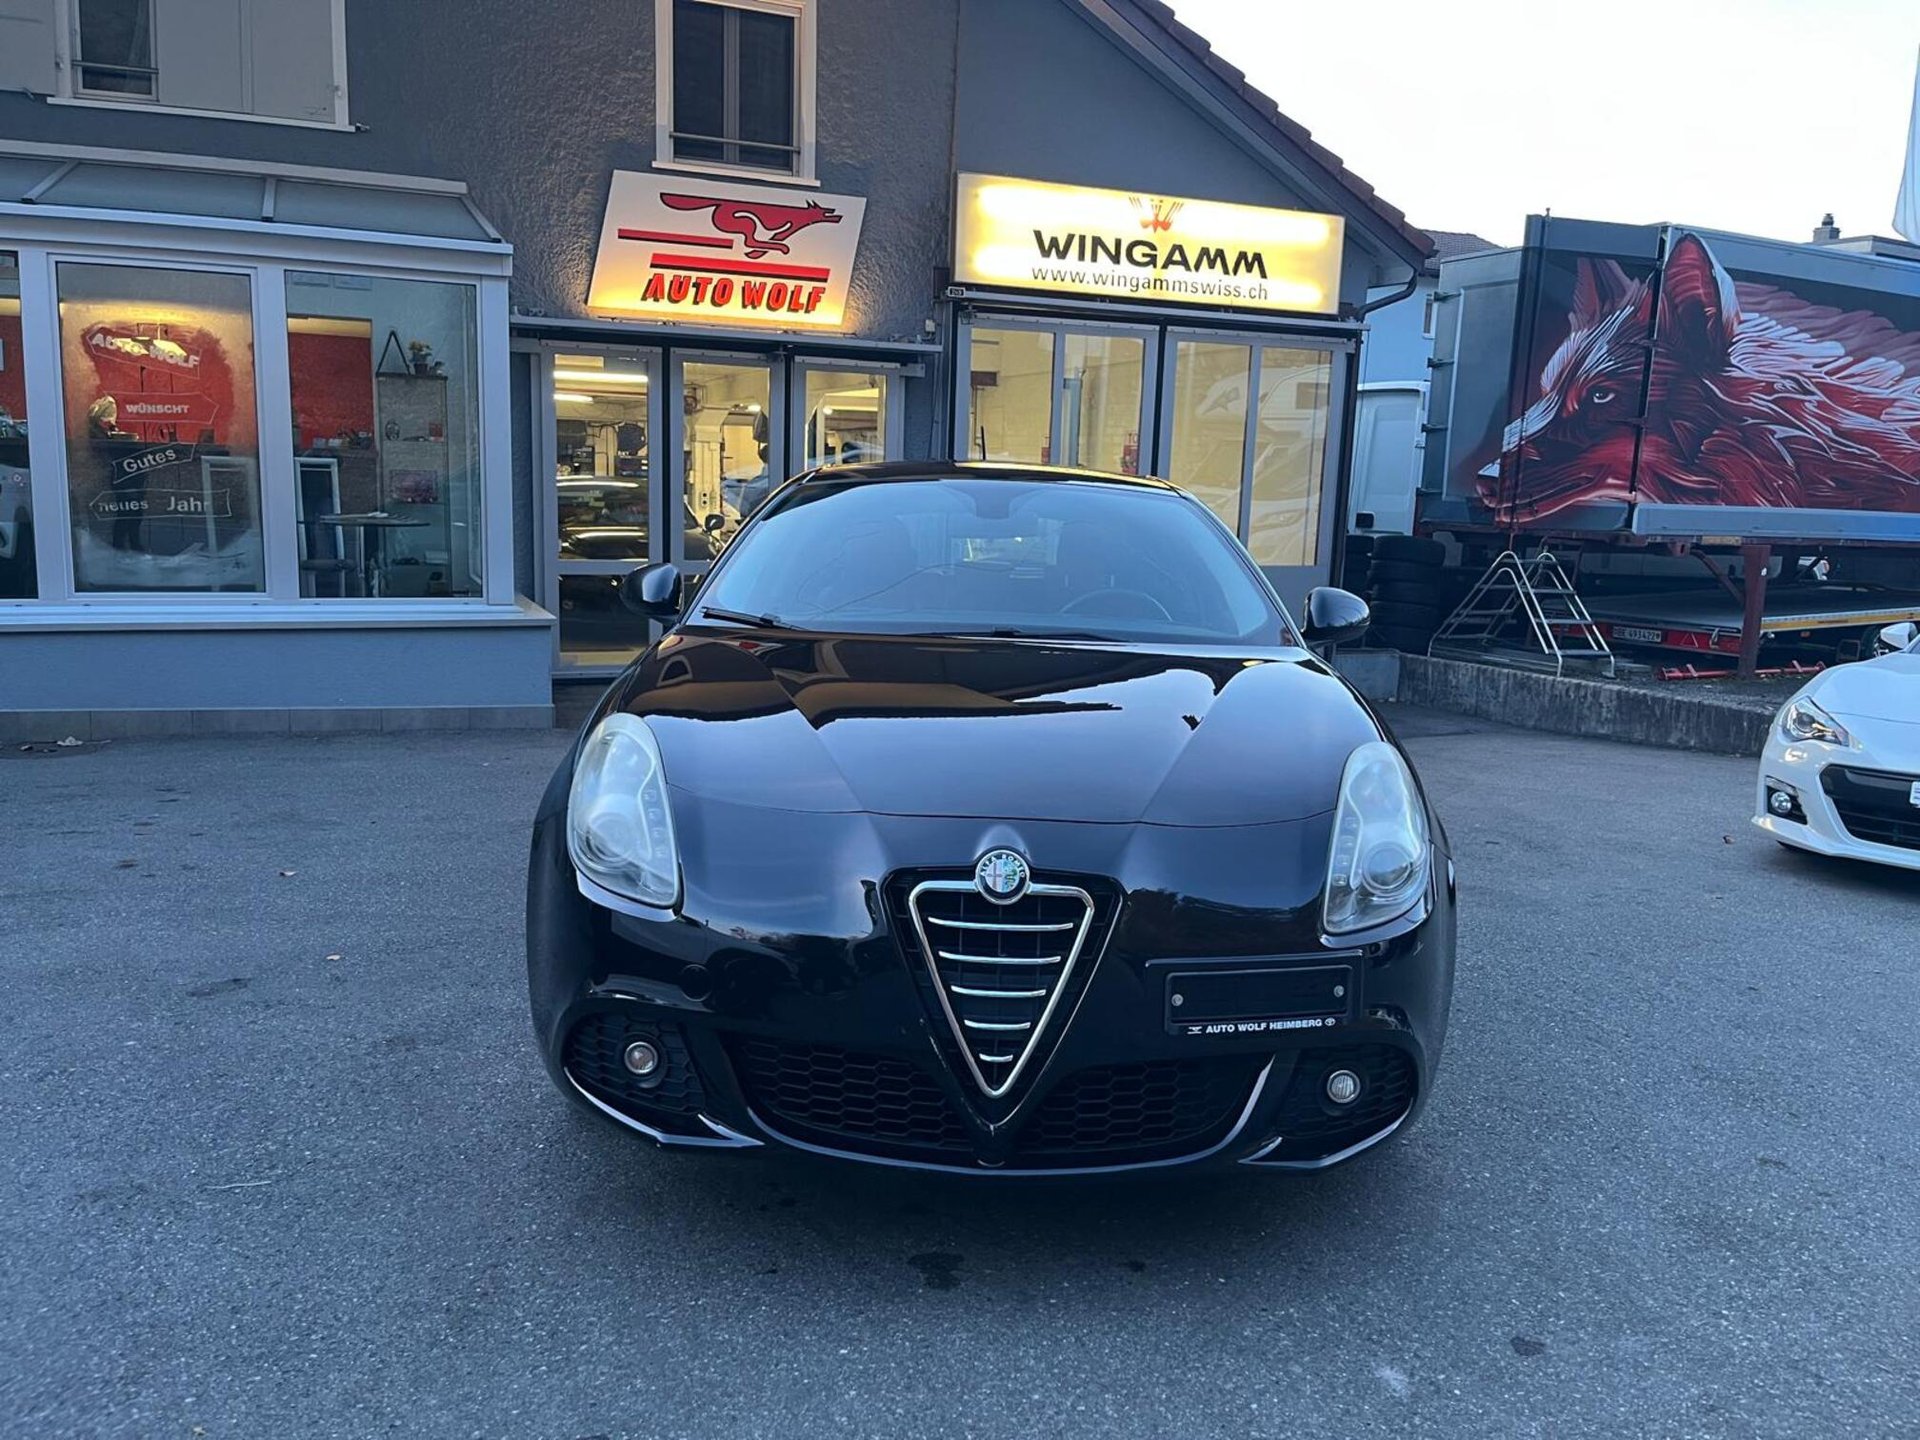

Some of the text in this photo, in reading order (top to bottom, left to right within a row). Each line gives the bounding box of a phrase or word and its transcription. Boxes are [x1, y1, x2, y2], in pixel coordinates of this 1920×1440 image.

[1033, 229, 1268, 279] WINGAMM
[640, 273, 826, 314] AUTO WOLF
[1032, 266, 1268, 301] www.wingammswiss.ch
[90, 333, 200, 369] AUTO WOLF
[126, 402, 190, 414] WÜNSCHT
[122, 449, 176, 473] Gutes
[98, 499, 149, 513] neues
[1206, 1018, 1322, 1034] AUTO WOLF HEIMBERG
